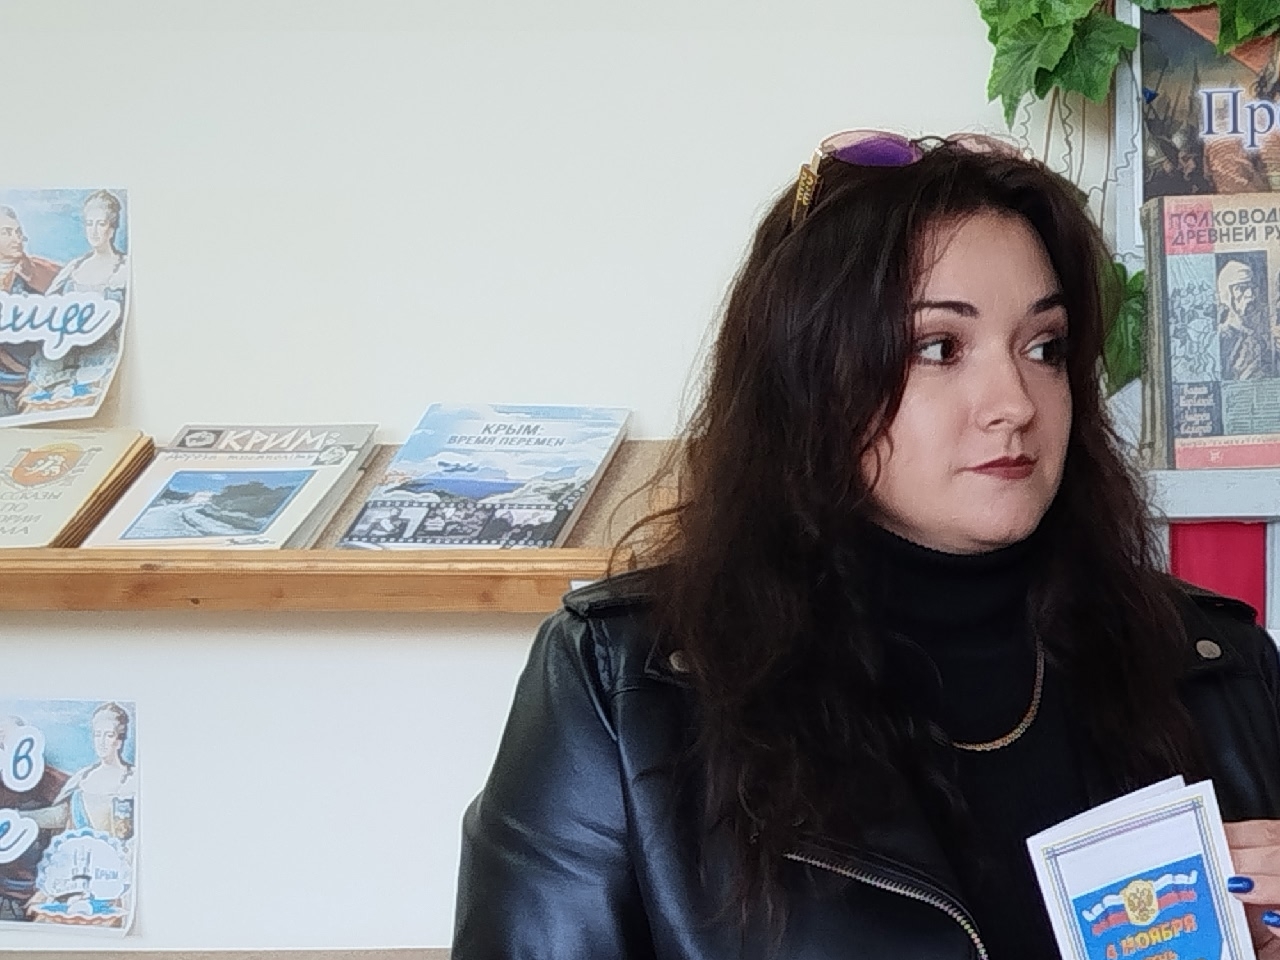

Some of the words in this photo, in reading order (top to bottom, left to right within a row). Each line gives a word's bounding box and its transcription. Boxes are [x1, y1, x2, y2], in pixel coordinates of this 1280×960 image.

[1172, 224, 1257, 246] ДРЕВНЕЙ
[0, 302, 111, 350] щее
[447, 435, 495, 445] ВРЕМЯ
[499, 436, 566, 446] ПЕРЕМЕН
[1121, 914, 1197, 956] НОЯБРЯ
